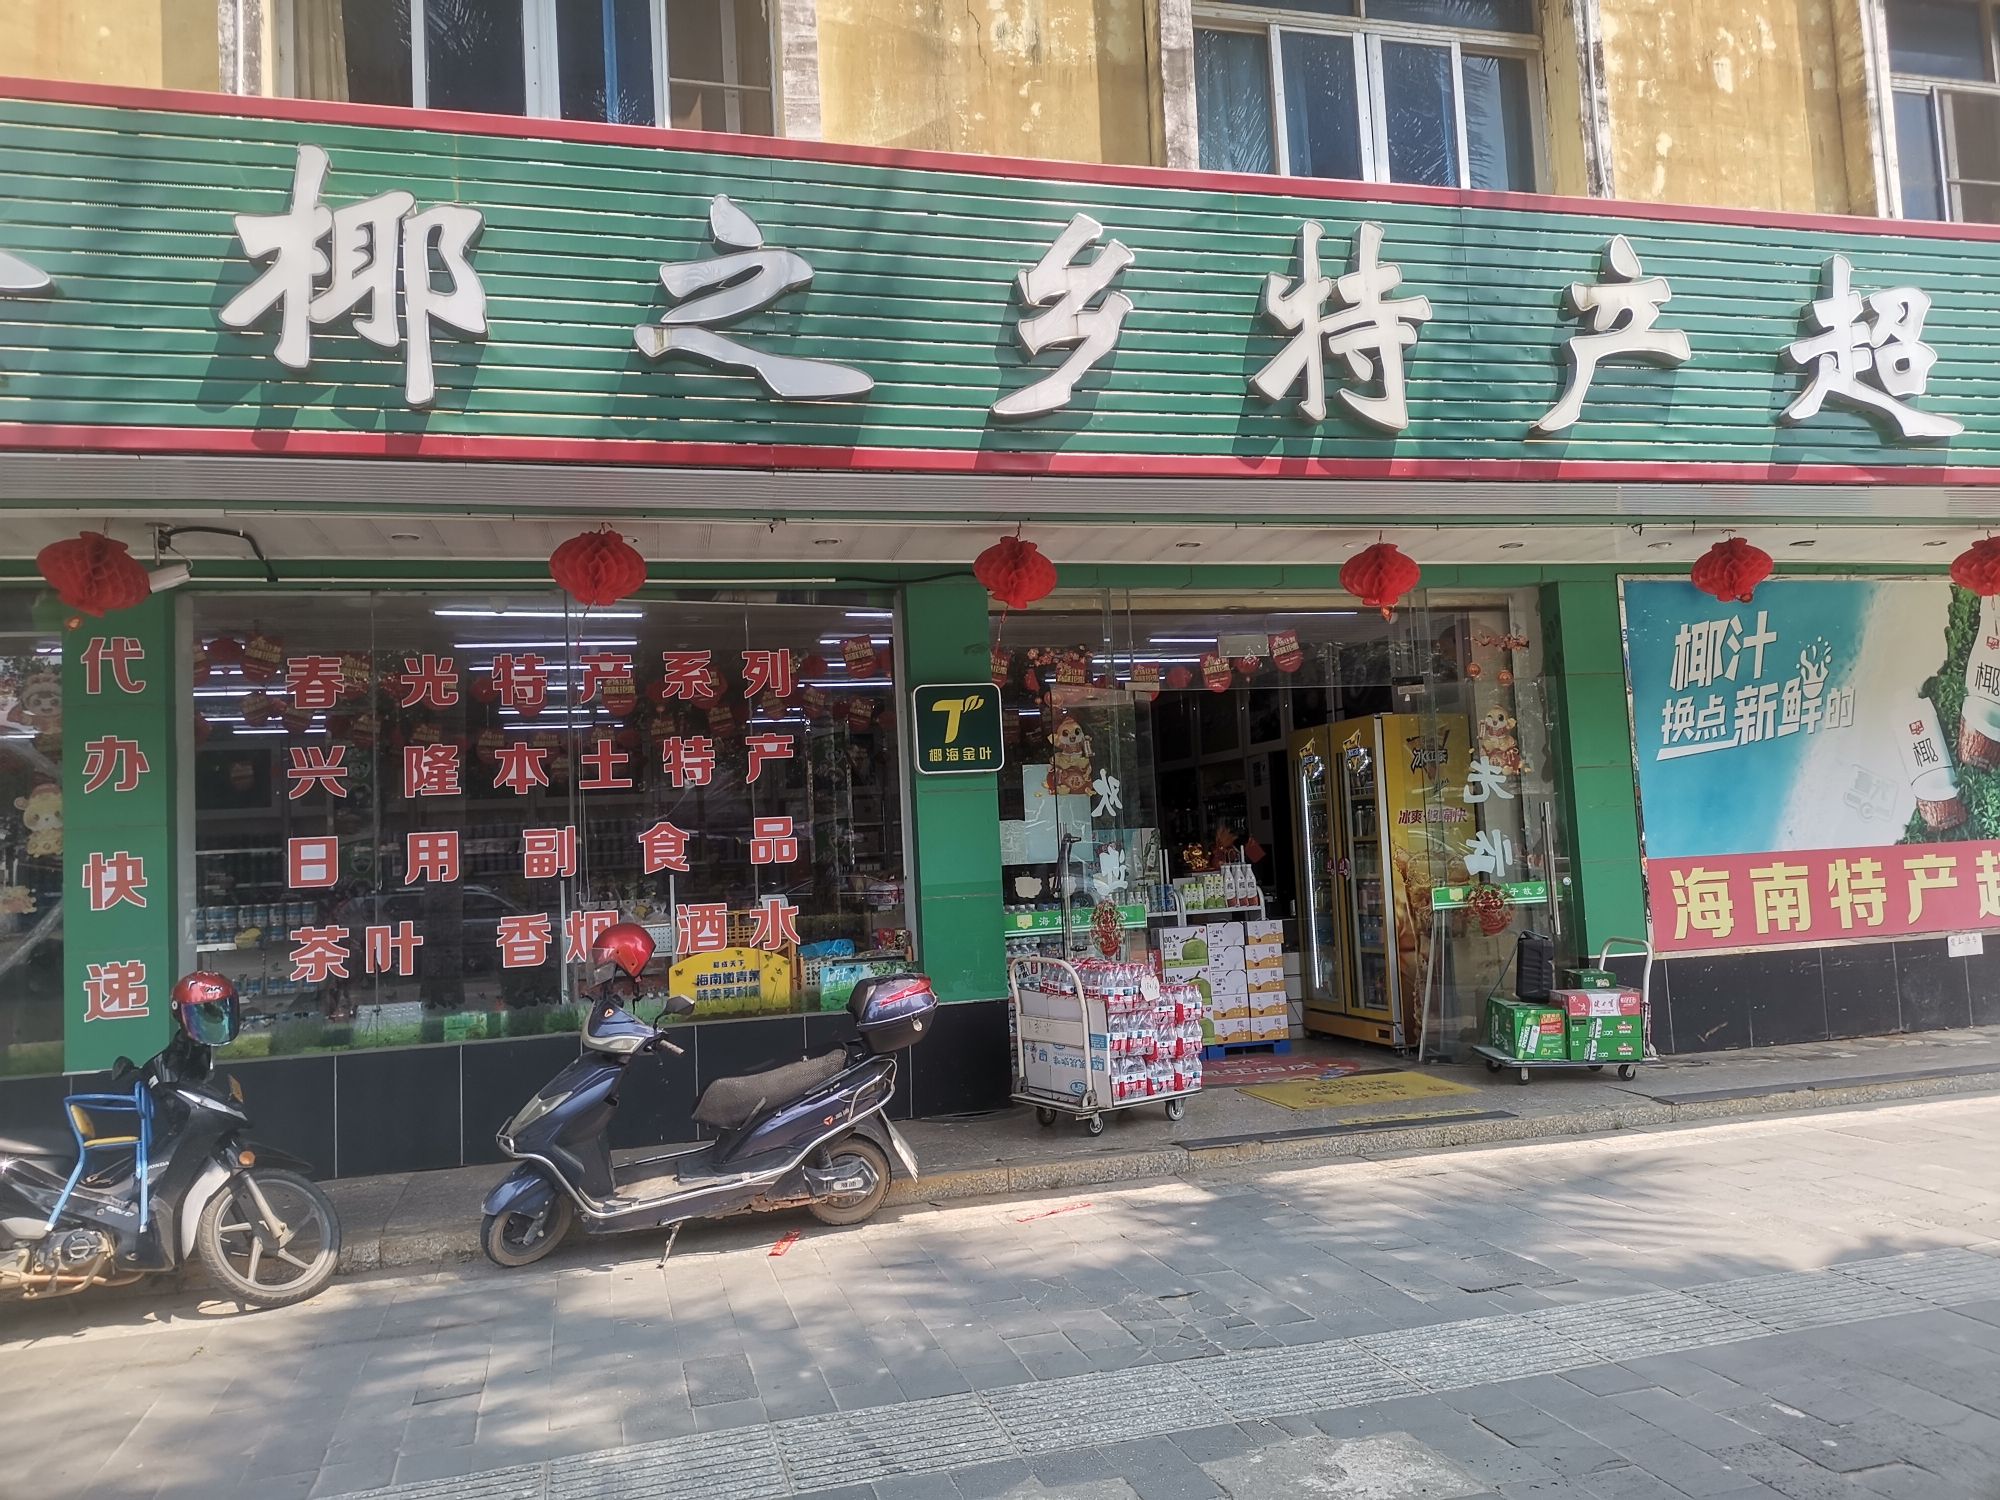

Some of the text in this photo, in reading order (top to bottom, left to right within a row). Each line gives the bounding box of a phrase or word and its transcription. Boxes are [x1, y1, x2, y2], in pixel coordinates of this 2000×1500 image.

[0, 143, 1964, 439] 椰之乡特产超
[286, 647, 792, 710] 春光特产系列
[1669, 610, 1778, 692] 椰汁
[1660, 677, 1857, 748] 换点新鲜的
[287, 732, 796, 800] 兴隆本土特产
[928, 746, 992, 762] 椰海金叶
[1912, 737, 1939, 768] 椰
[80, 636, 151, 1024] 代办快递
[287, 815, 799, 889] 日用副食品
[289, 920, 424, 983] 茶叶
[676, 899, 802, 956] 酒水
[147, 1160, 170, 1170] ONDA
